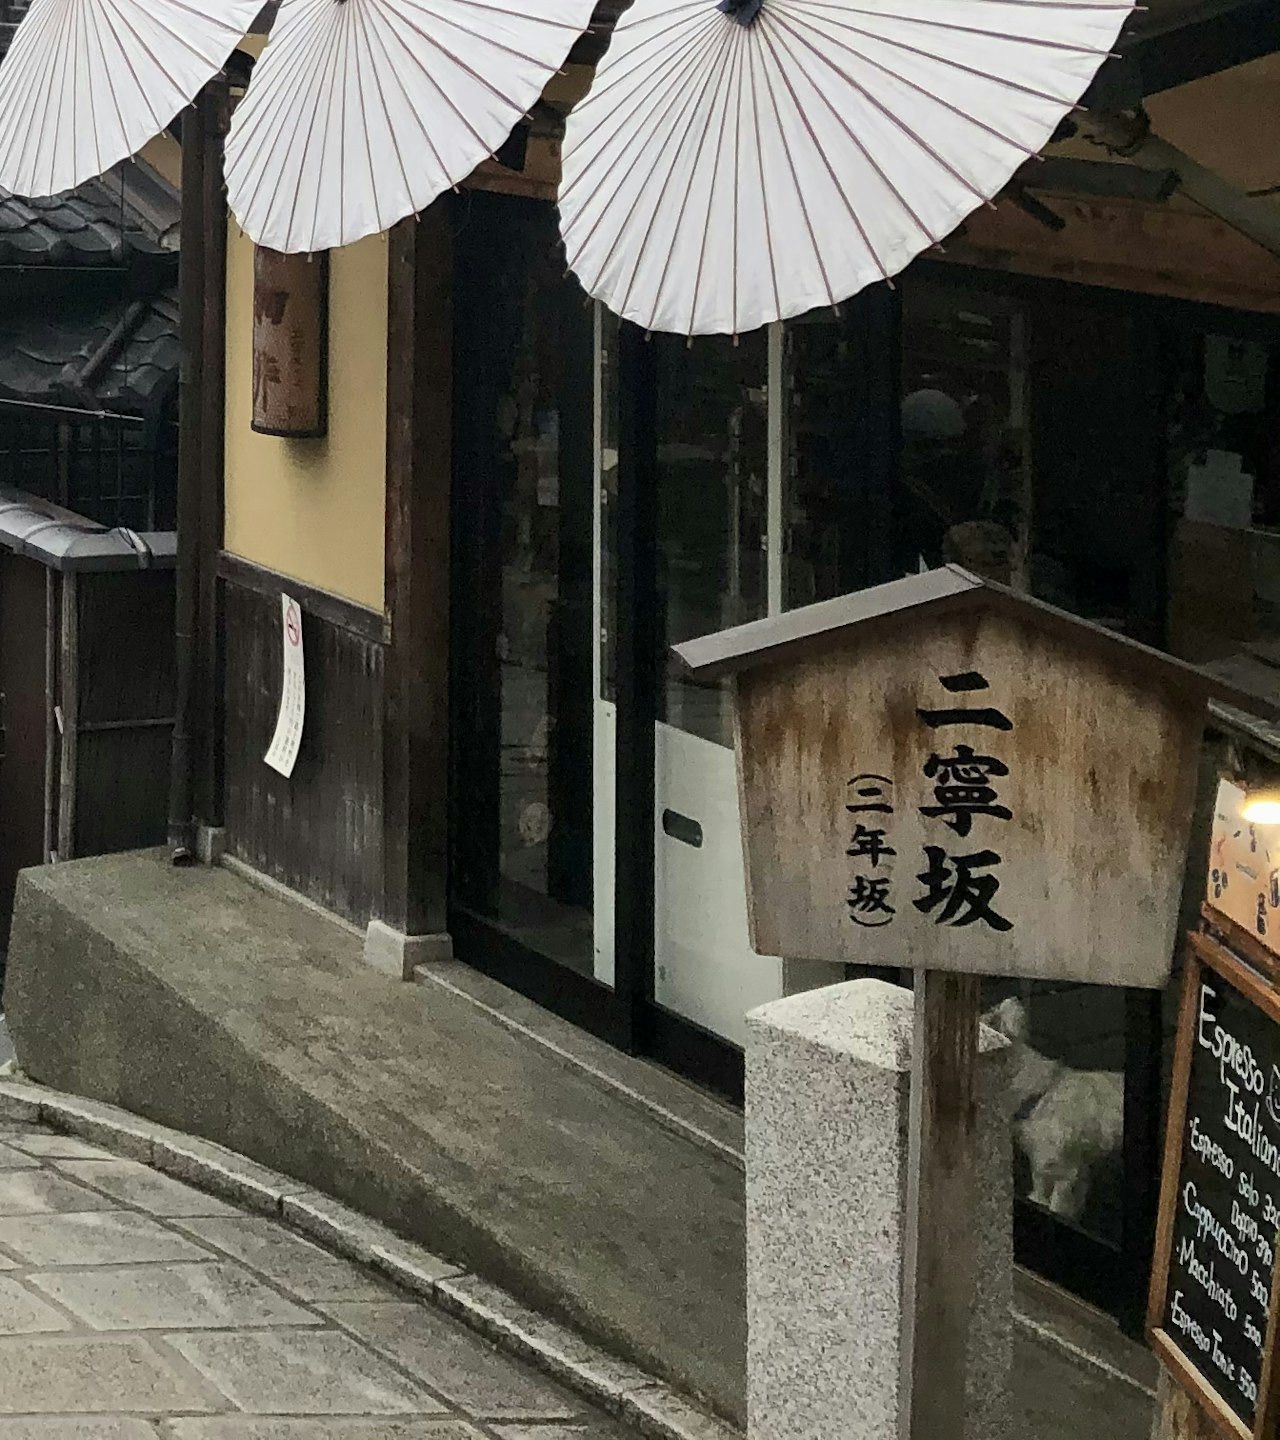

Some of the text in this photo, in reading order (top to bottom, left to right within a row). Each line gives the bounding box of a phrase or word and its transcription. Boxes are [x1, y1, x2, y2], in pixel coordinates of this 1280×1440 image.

[845, 773, 898, 928] （二年坂）
[912, 670, 1014, 932] 二寧坂
[1198, 983, 1265, 1096] Espresso
